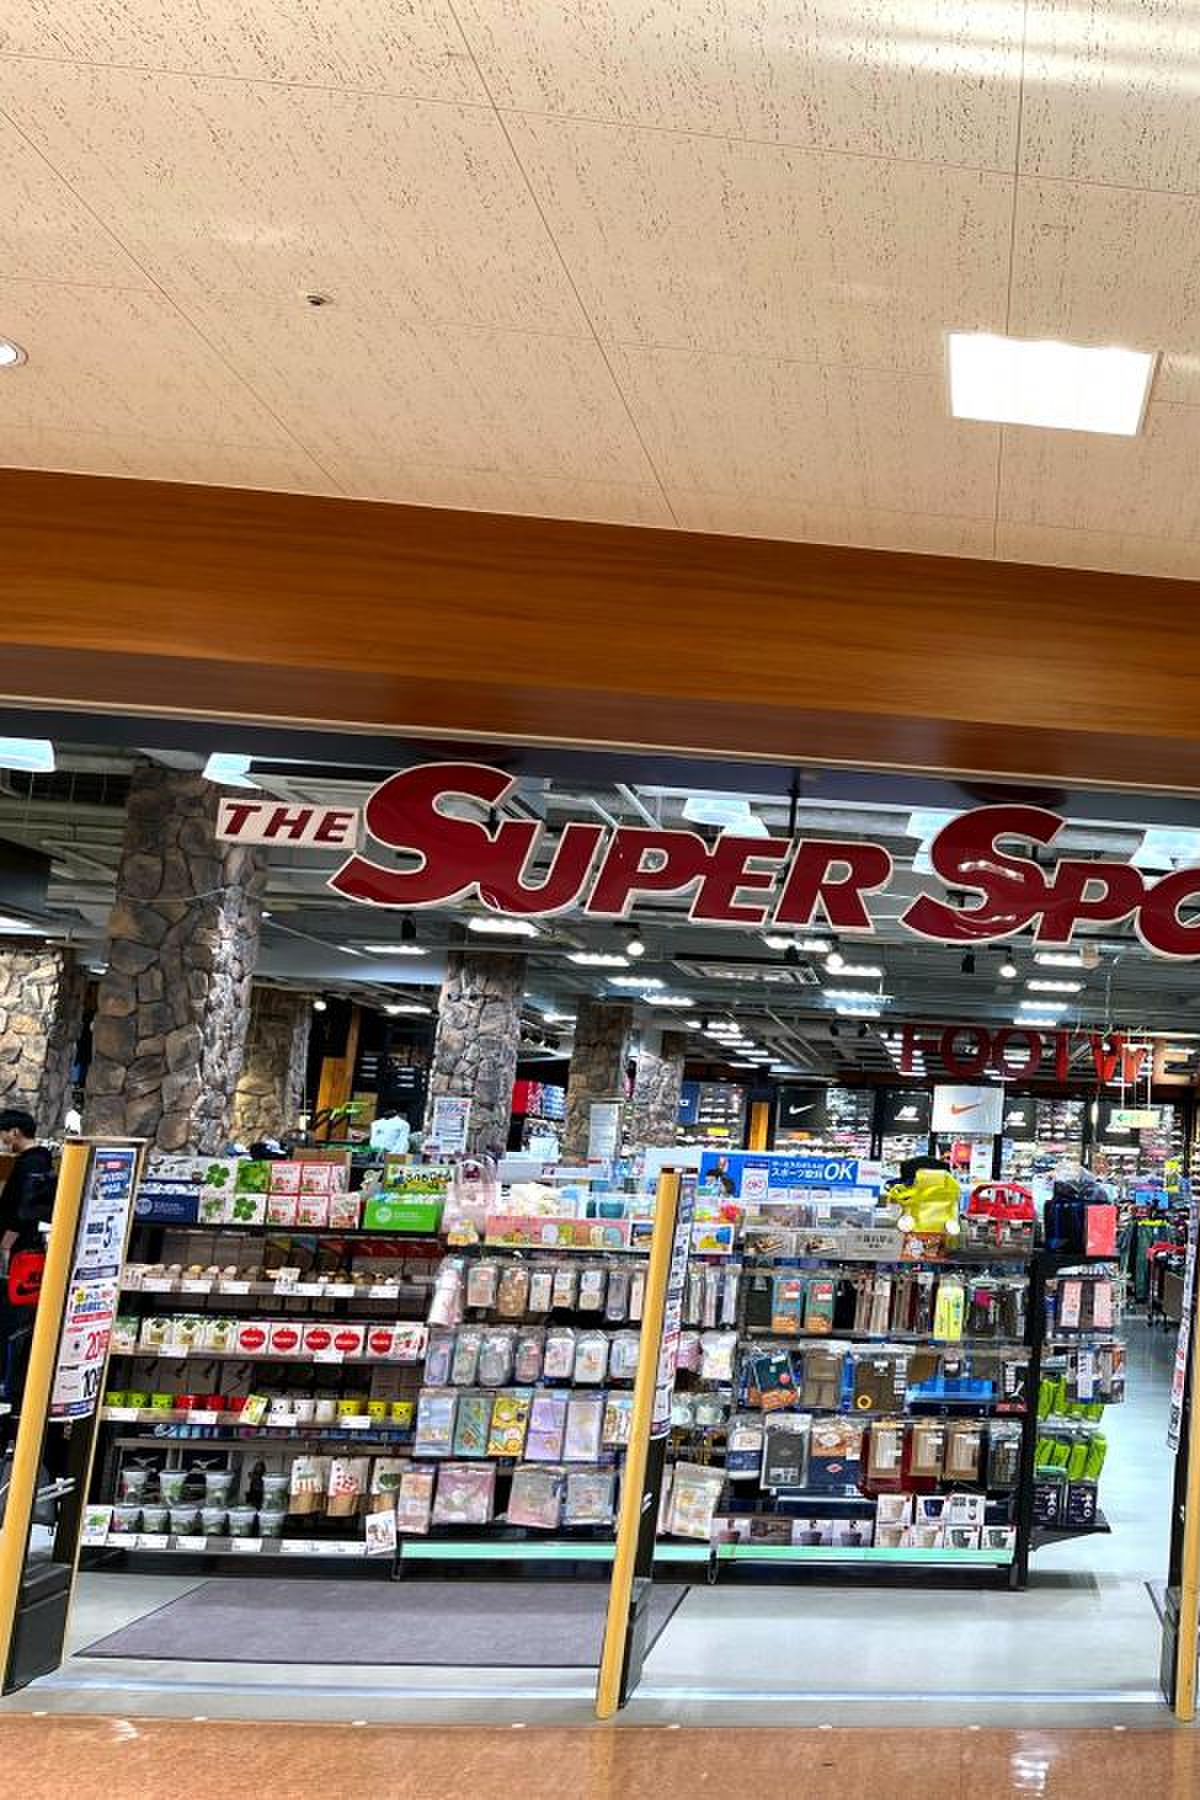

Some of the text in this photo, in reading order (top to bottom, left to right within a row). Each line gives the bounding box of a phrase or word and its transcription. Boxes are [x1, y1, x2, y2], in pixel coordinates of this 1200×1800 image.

[223, 803, 353, 843] THE
[328, 762, 892, 934] SUPER
[823, 1161, 856, 1180] OK
